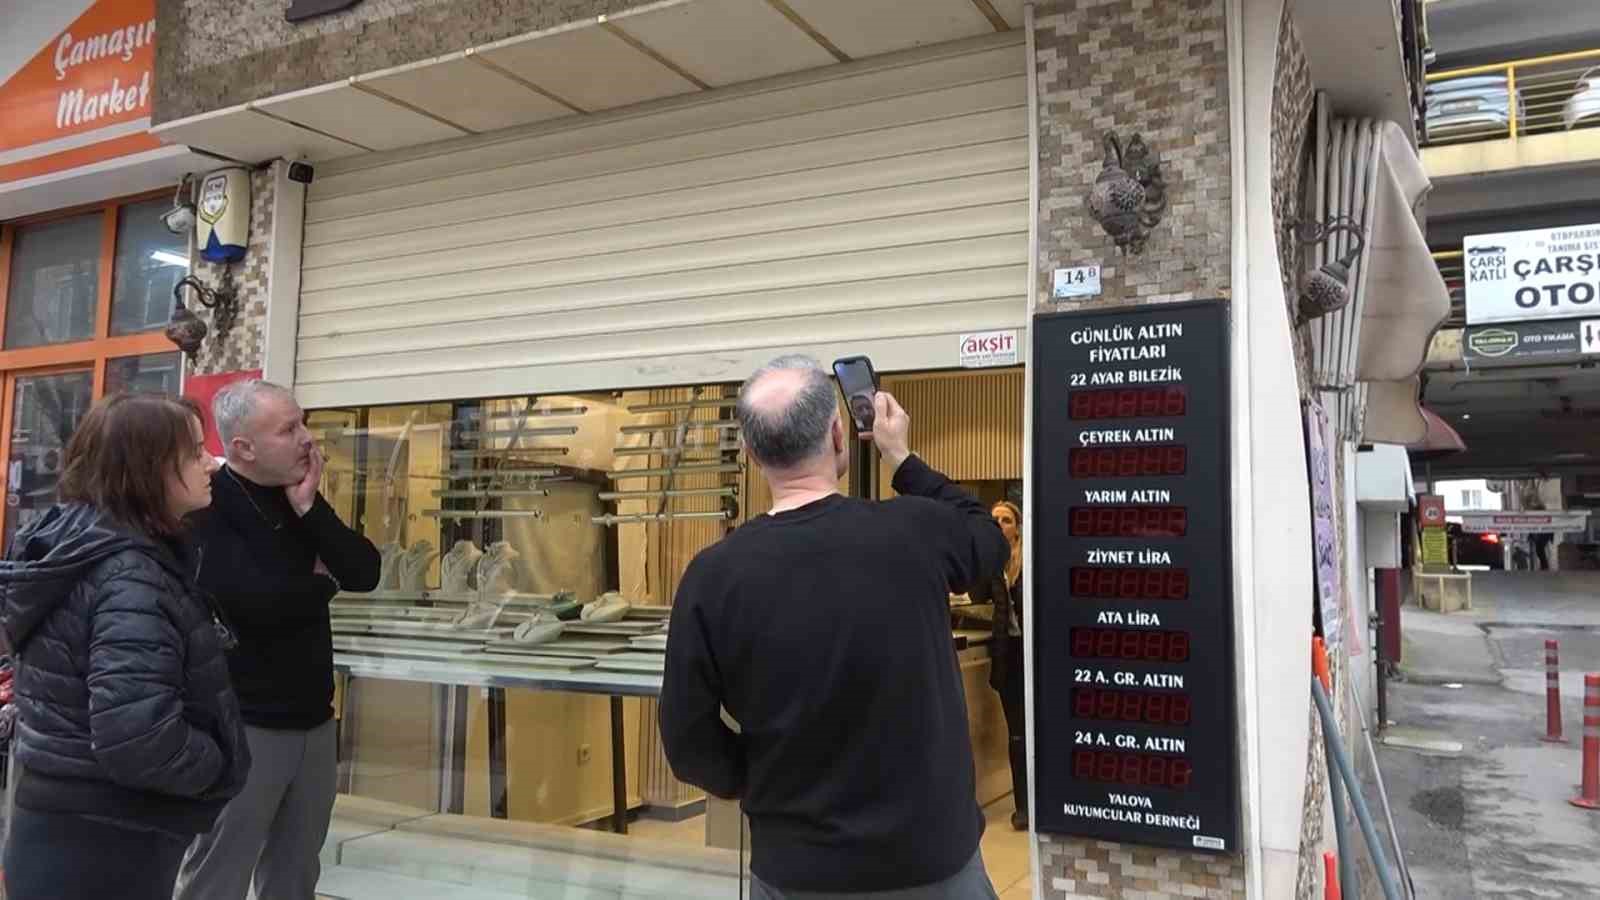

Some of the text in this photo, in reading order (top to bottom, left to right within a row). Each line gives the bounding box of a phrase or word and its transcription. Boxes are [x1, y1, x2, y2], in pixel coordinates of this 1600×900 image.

[54, 18, 156, 80] Çamaşır
[56, 71, 150, 129] Market
[1064, 270, 1085, 284] 14
[1470, 268, 1507, 282] KATLI
[1514, 282, 1600, 308] OTO
[1070, 323, 1183, 345] GÜNLÜK ALTIN
[1089, 344, 1166, 363] FİYATLARI
[1070, 373, 1087, 387] 22
[1090, 371, 1125, 385] AYAR
[1079, 428, 1174, 447] ÇEYREK ALTIN
[1085, 489, 1170, 503] YARIM ALTIN
[1087, 548, 1172, 565] ZİYNET LİRA
[1097, 609, 1161, 626] ATA LİRA
[1074, 669, 1184, 689] 22 A. GR. ALTIN
[1075, 731, 1186, 753] 24 A. GR. ALTIN
[1108, 793, 1153, 809] YALOVA
[1063, 803, 1201, 831] KUYUMCULAR DERNEĞİ
